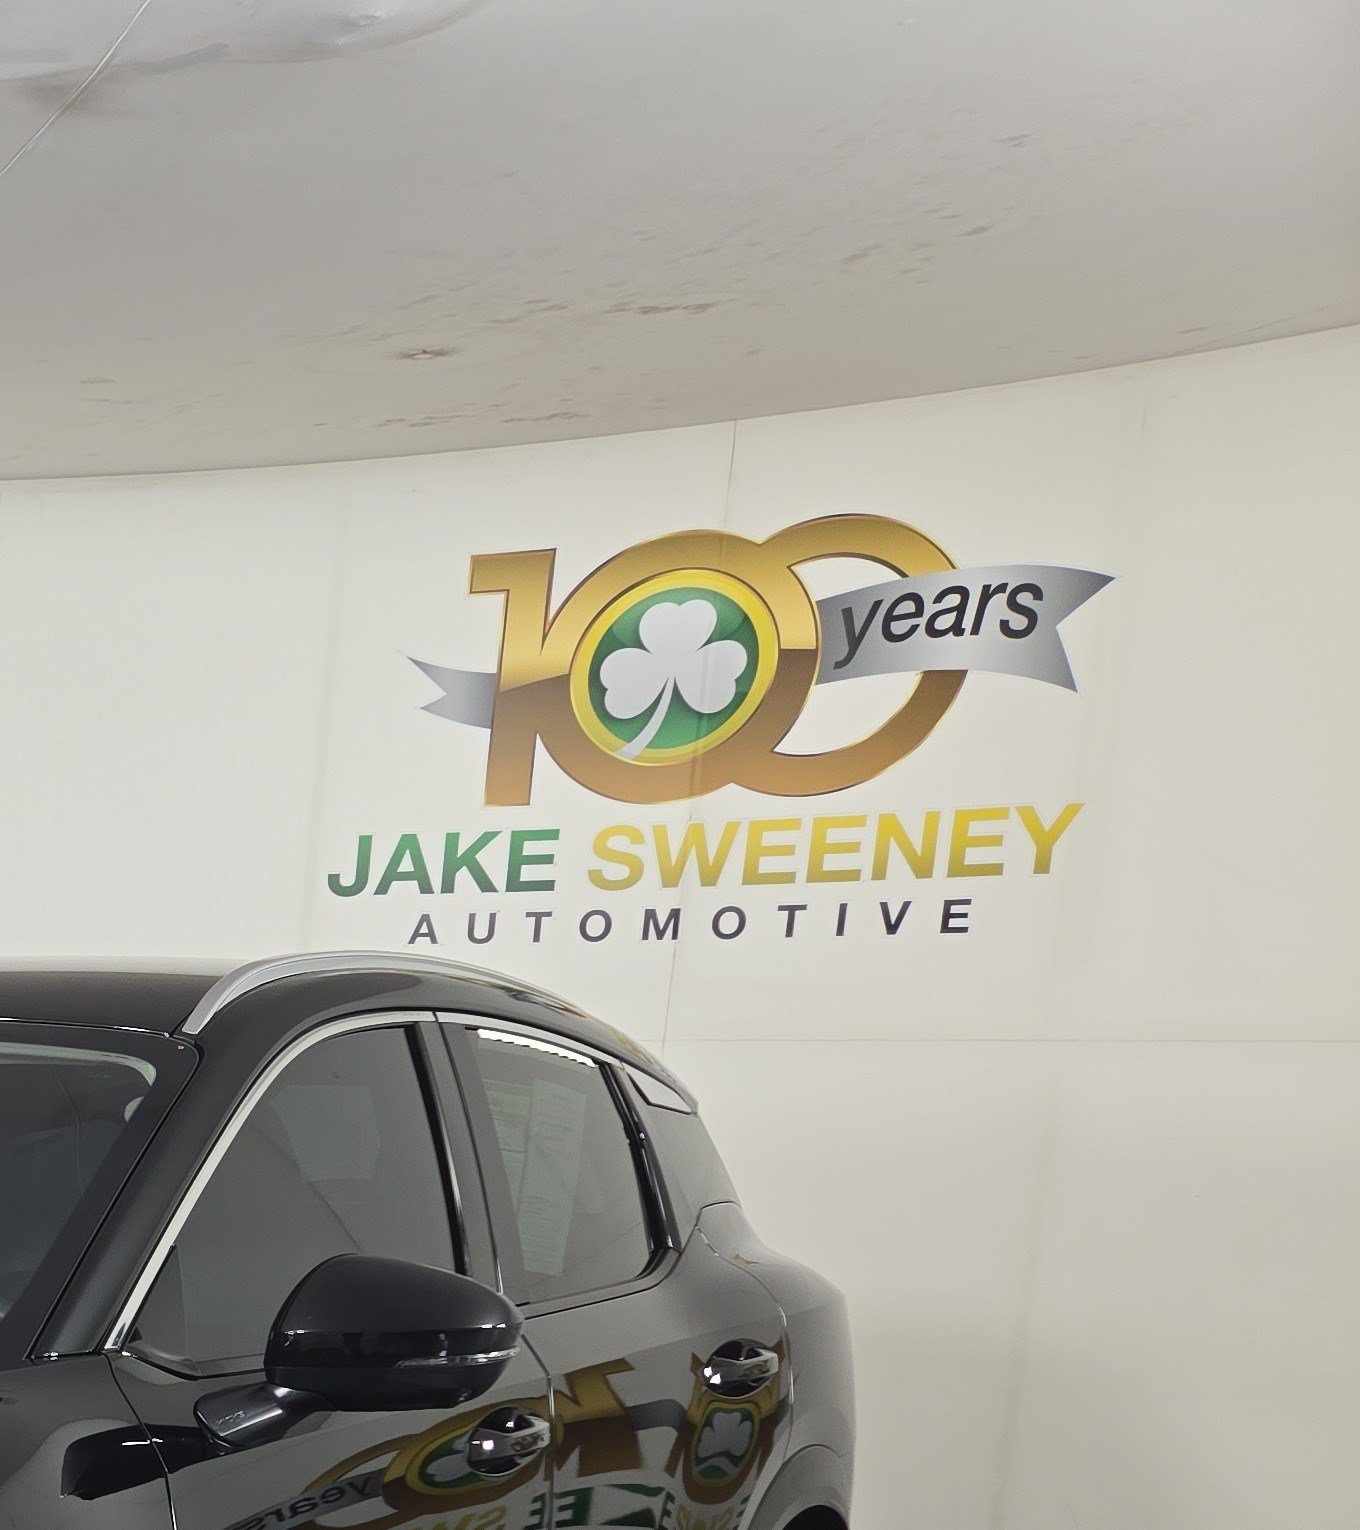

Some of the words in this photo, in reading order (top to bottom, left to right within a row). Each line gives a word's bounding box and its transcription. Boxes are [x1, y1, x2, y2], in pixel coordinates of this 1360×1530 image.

[832, 581, 1045, 671] years
[326, 828, 561, 899] JAKE
[586, 802, 1085, 893] SWEENEY
[407, 898, 974, 946] AUTOMOTIVE
